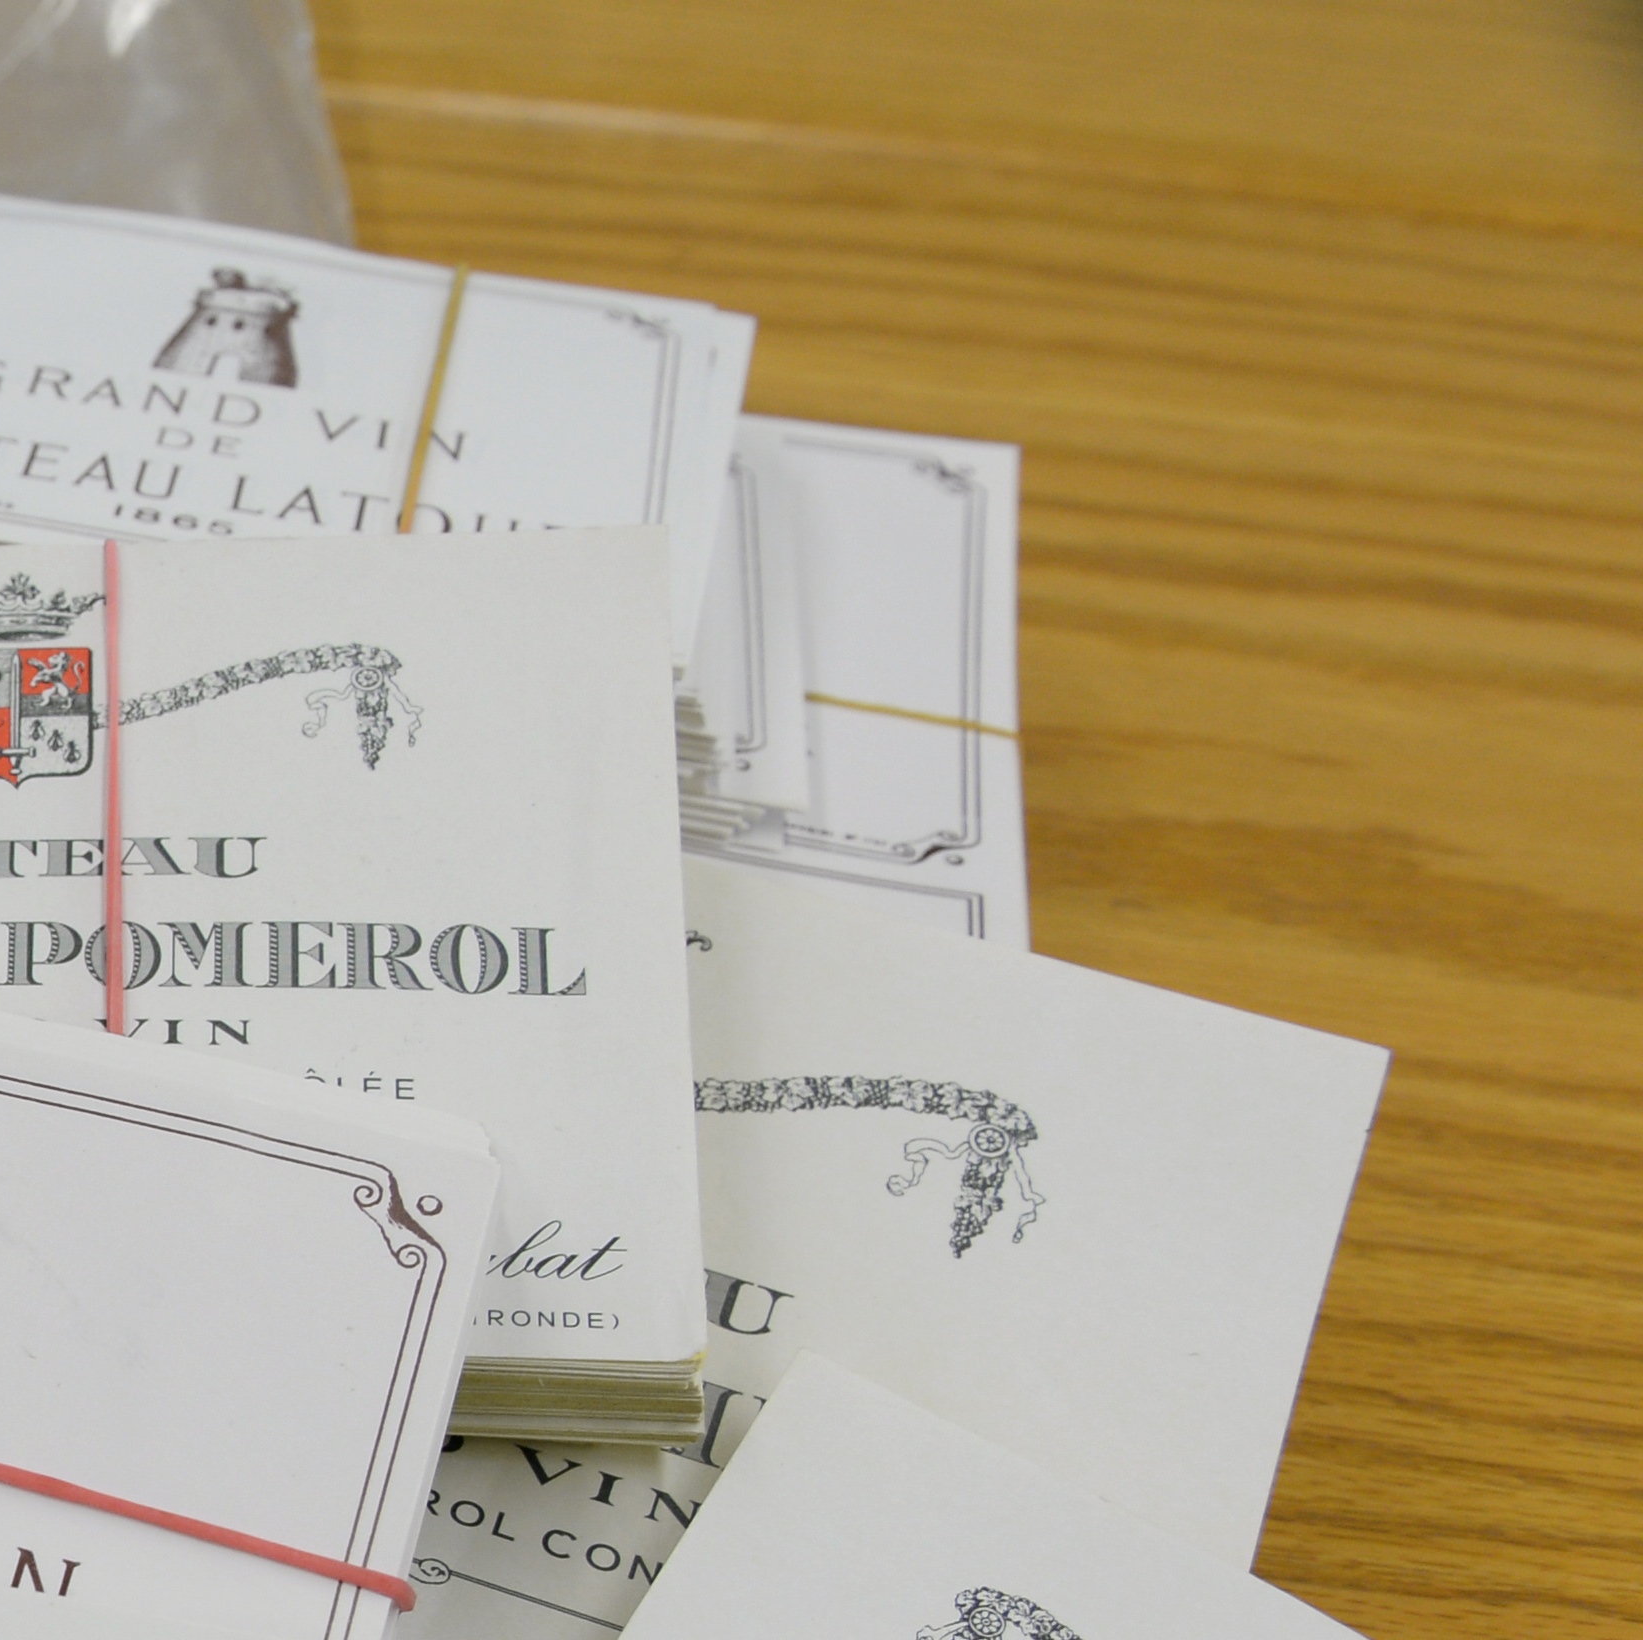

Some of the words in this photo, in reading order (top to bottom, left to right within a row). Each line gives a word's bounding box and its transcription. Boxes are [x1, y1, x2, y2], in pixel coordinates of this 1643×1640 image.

[154, 426, 245, 460] DE
[314, 408, 472, 462] VIN
[113, 504, 236, 537] 1865
